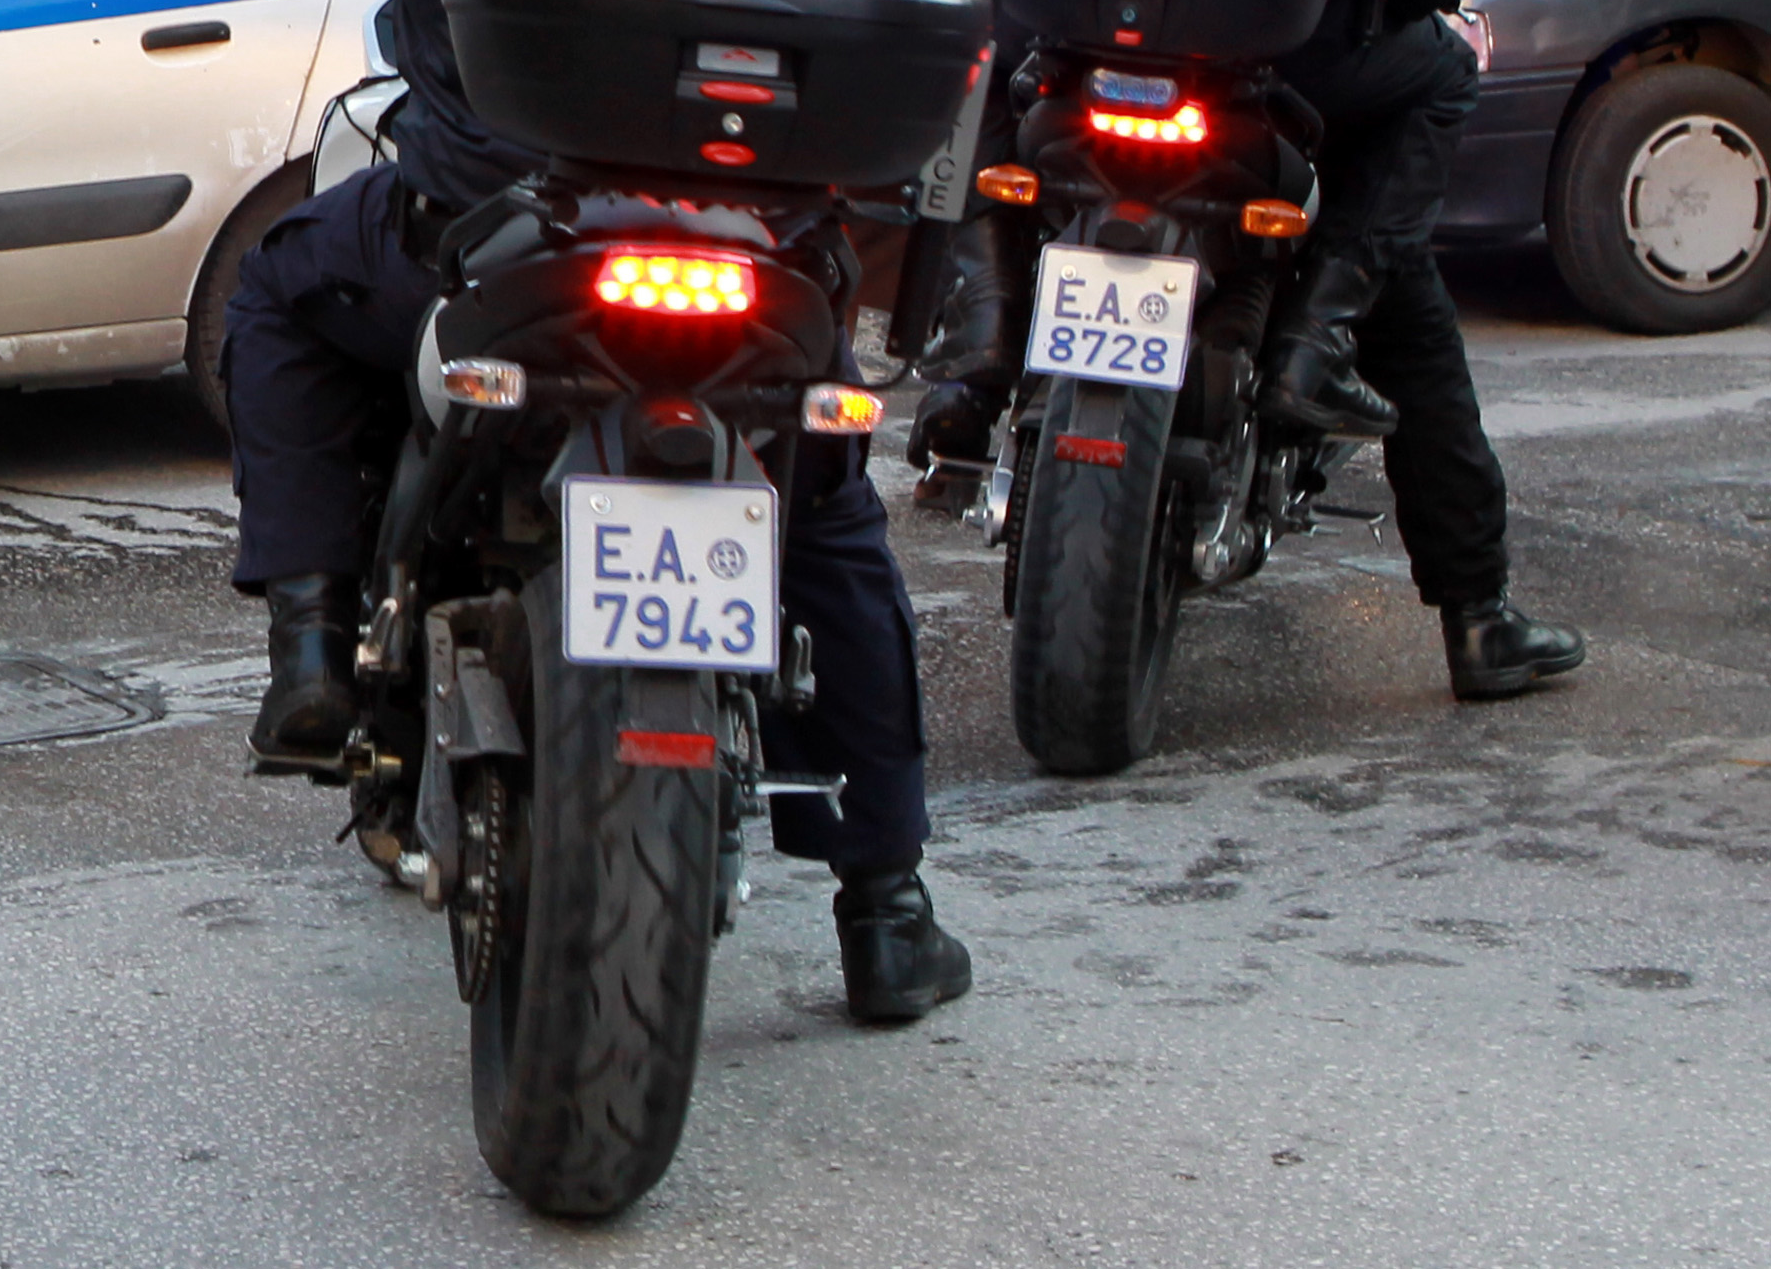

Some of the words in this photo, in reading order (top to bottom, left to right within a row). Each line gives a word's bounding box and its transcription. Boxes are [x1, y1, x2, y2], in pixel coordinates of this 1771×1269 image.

[1052, 278, 1130, 326] E.A.
[1048, 327, 1170, 375] 8728
[593, 524, 697, 584] E.A.
[593, 593, 757, 655] 7943
